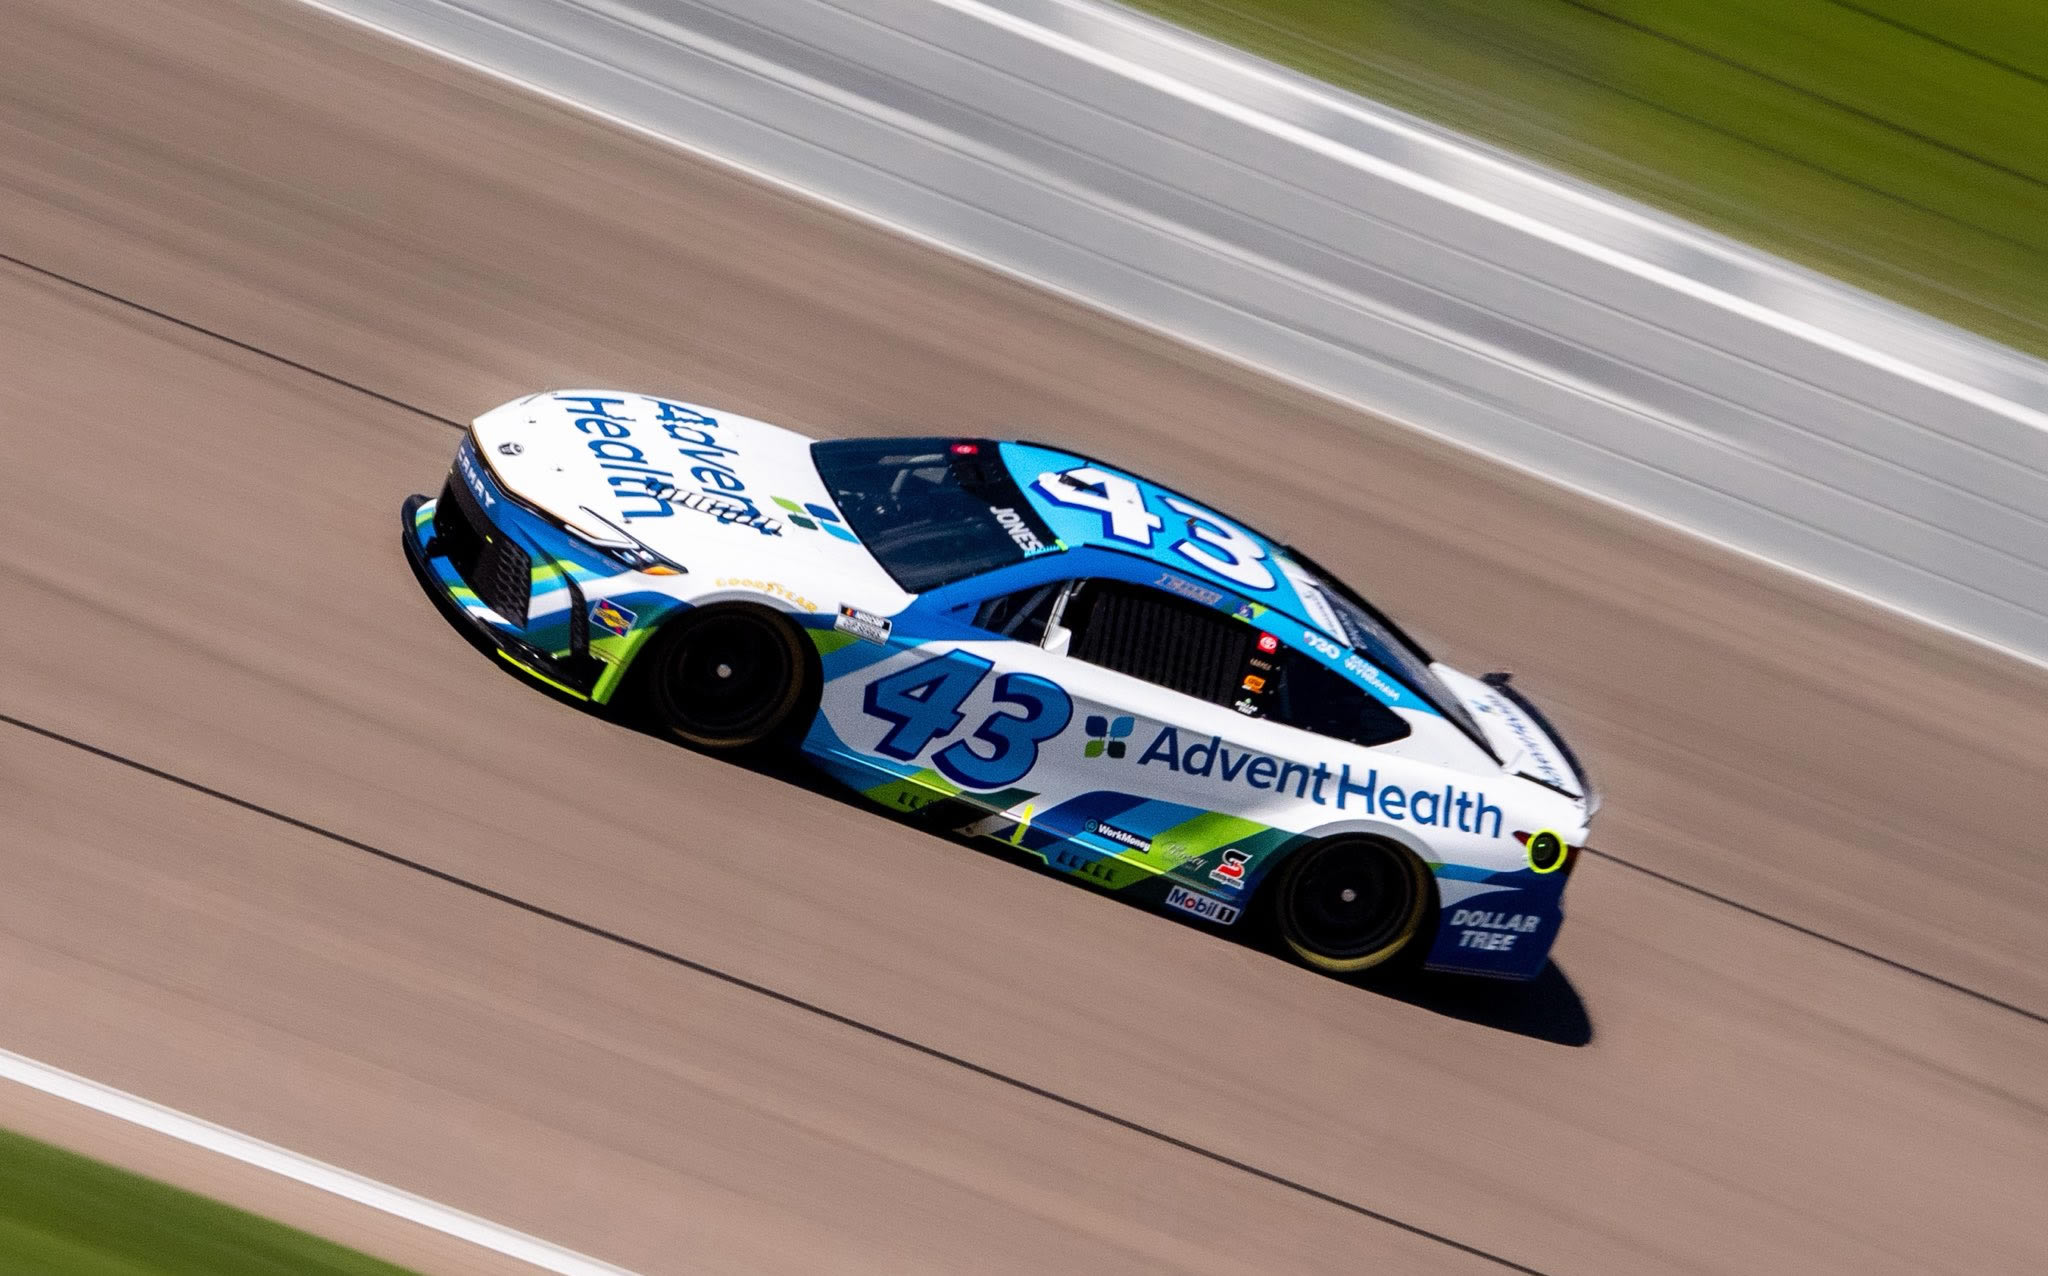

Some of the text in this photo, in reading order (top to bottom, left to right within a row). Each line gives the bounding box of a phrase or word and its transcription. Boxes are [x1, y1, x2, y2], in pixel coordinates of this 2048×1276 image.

[553, 396, 676, 518] Health
[989, 506, 1044, 551] JONES
[1029, 467, 1277, 591] 43
[863, 648, 1074, 789] 43
[1137, 726, 1502, 838] AdventHealth
[1098, 823, 1151, 852] WorkMoney
[1169, 888, 1218, 917] Mobil
[1450, 909, 1541, 932] DOLLAR
[1459, 930, 1517, 951] TREE
